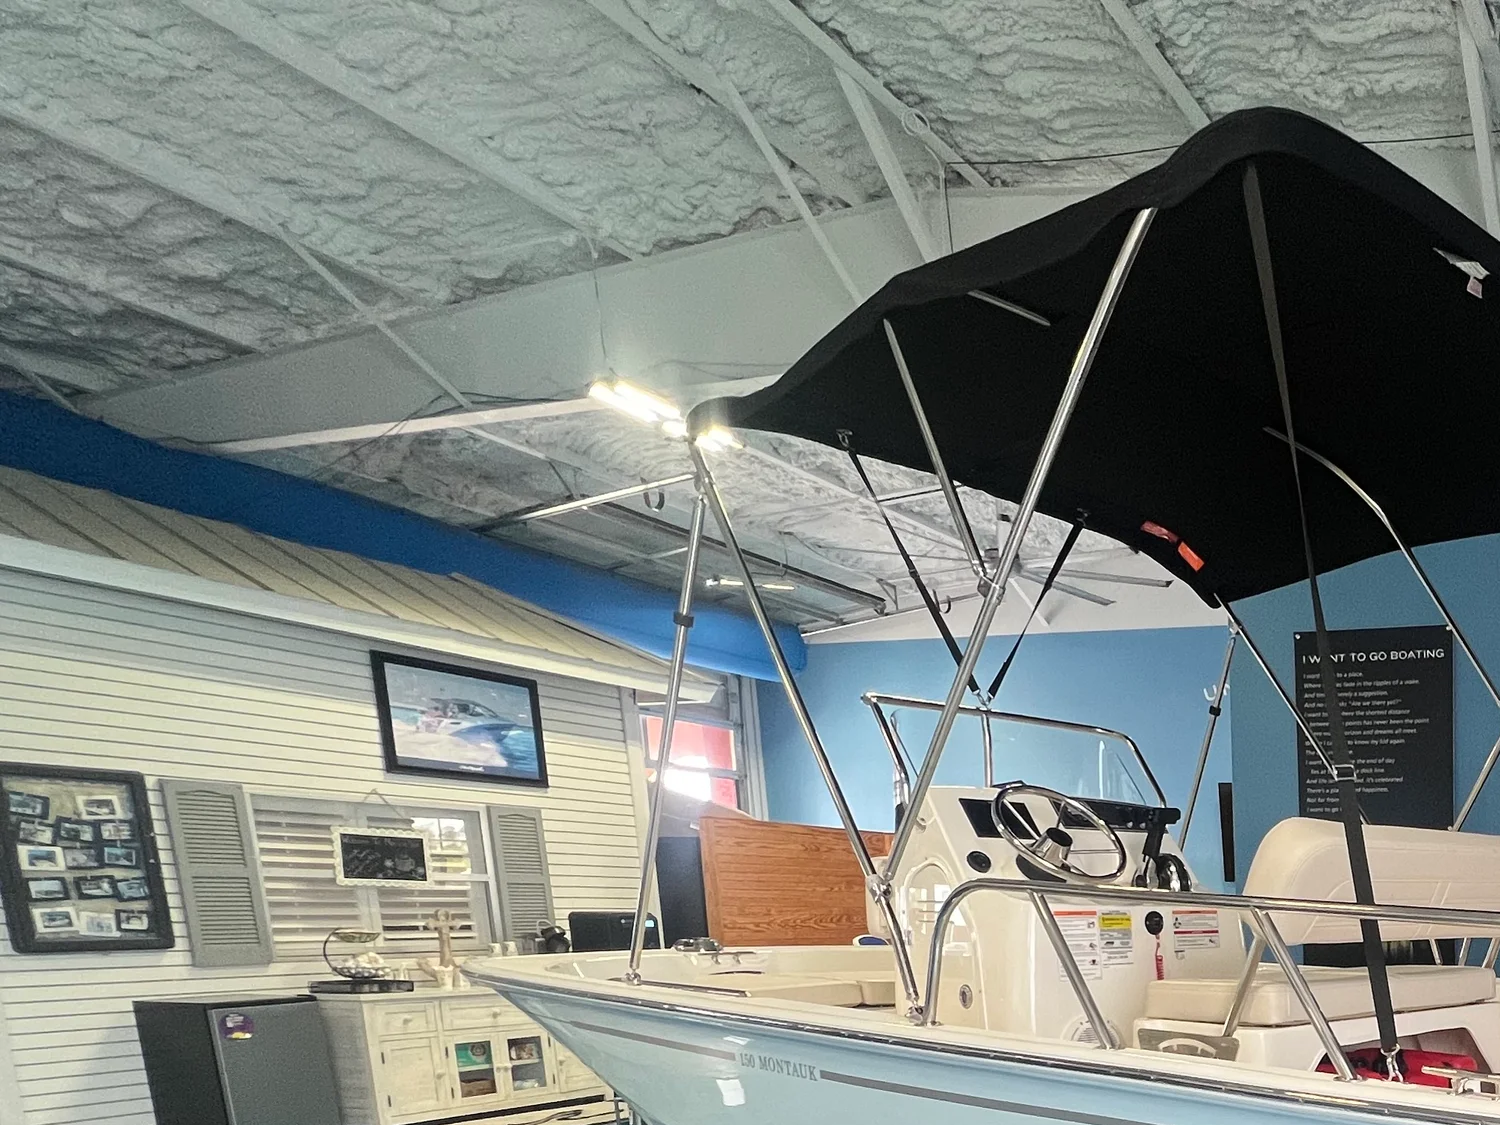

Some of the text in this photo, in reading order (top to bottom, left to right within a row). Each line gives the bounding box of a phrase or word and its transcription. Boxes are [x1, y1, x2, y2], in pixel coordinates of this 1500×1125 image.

[1302, 648, 1445, 664] I WNT TO GO BOATING
[740, 1052, 818, 1081] 150 MONTAUK
